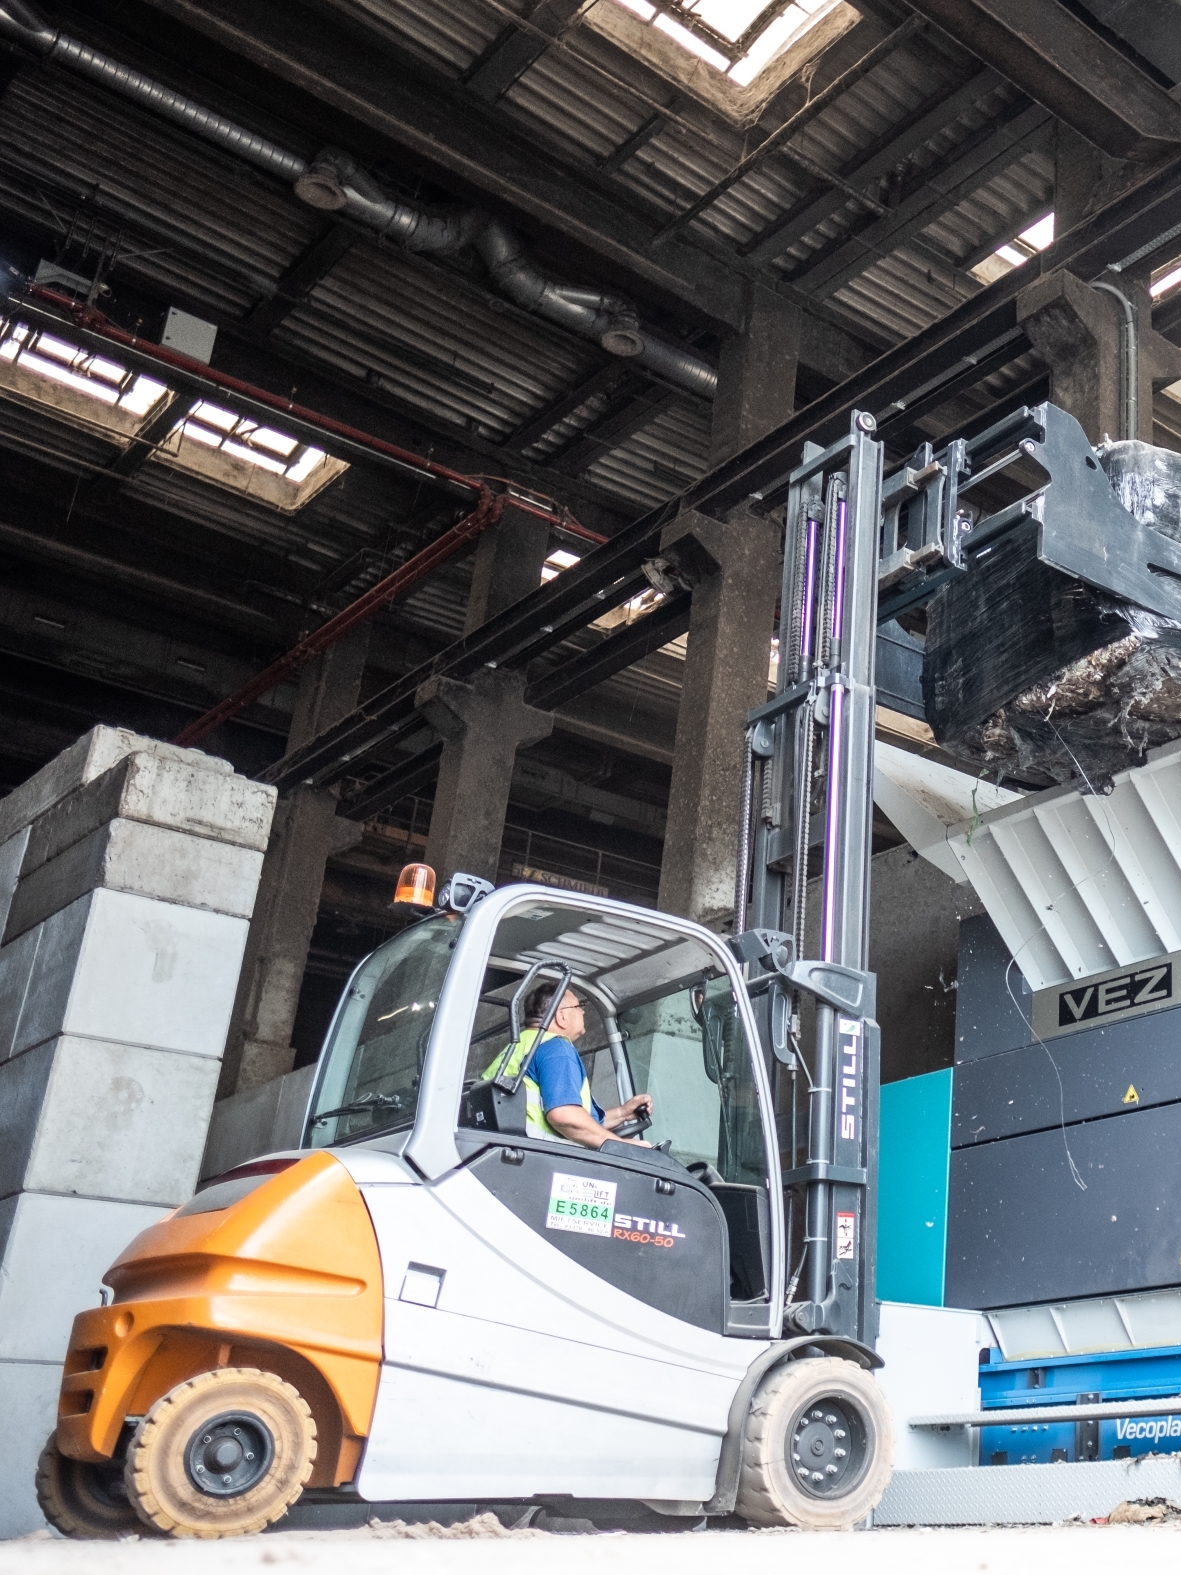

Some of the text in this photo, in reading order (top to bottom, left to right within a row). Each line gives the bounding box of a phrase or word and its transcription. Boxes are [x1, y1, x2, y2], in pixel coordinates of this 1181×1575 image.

[1062, 965, 1170, 1022] VEZ
[841, 1036, 858, 1140] STILL
[613, 1228, 675, 1248] RX60-50
[614, 1213, 686, 1238] STILL
